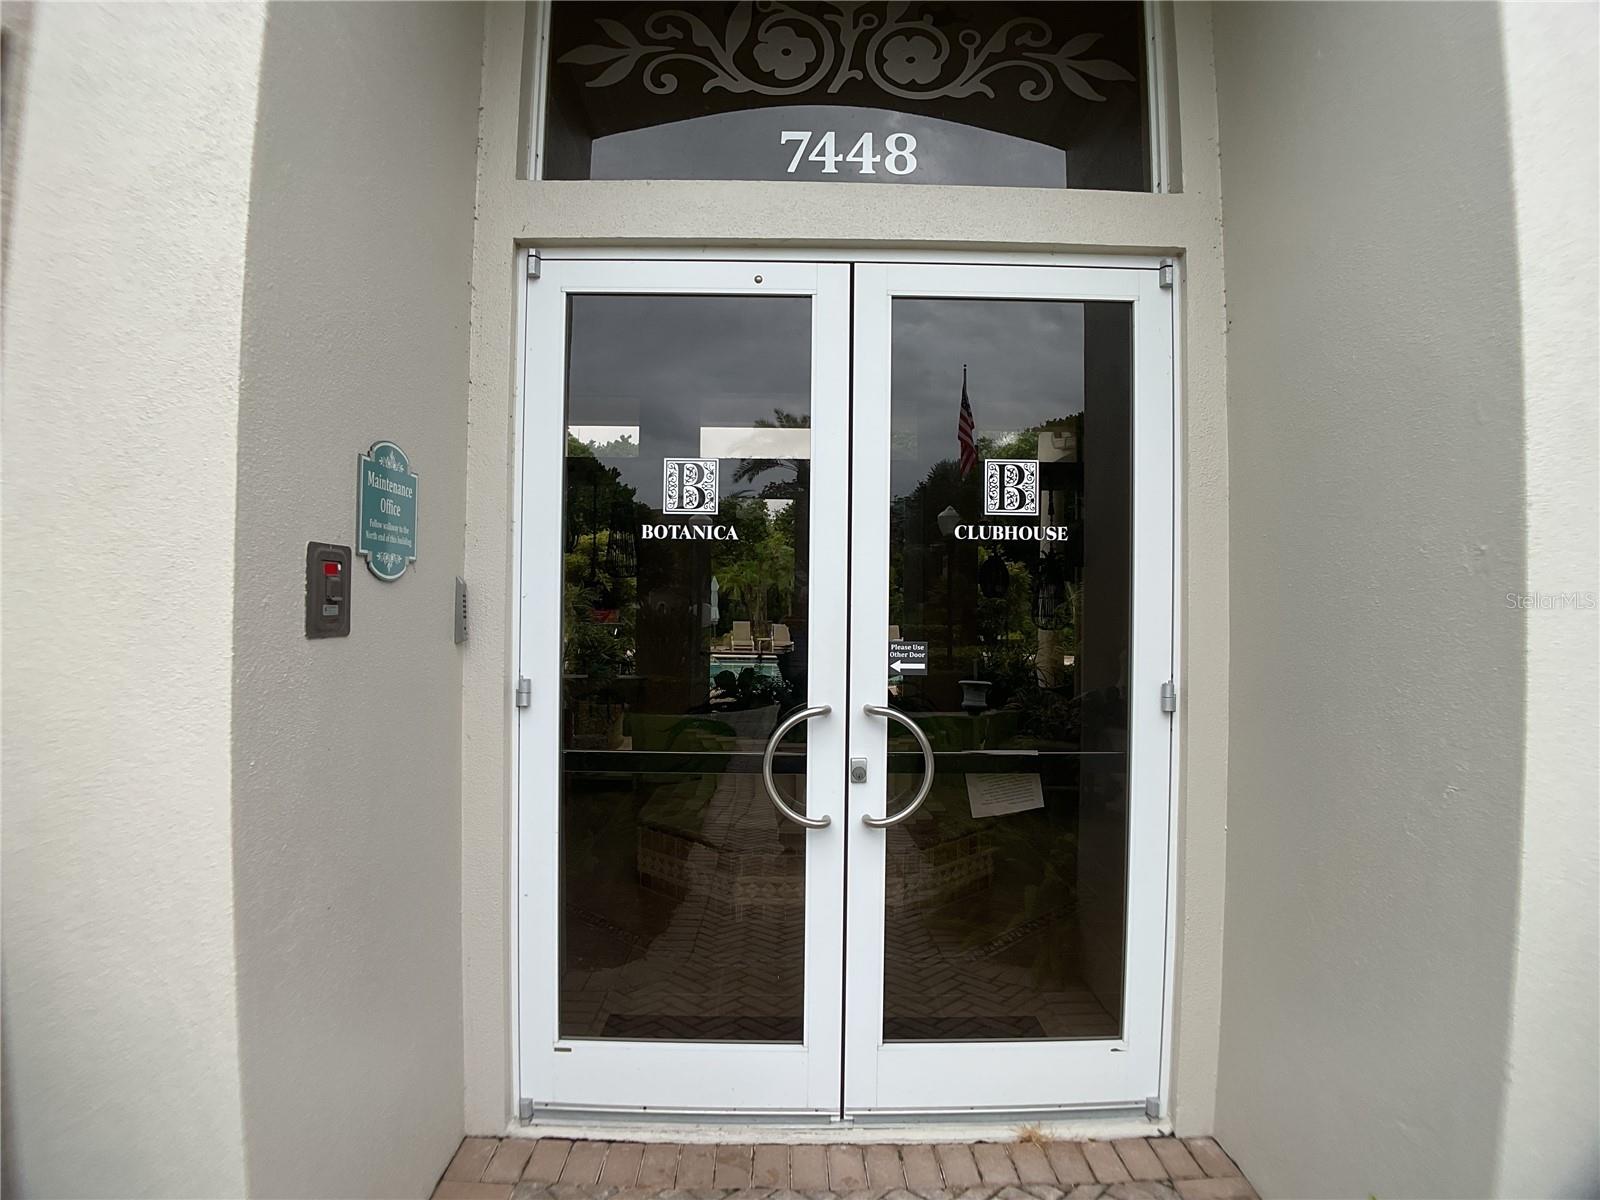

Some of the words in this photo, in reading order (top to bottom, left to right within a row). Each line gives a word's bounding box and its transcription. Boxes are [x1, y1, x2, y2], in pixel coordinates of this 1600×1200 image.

[780, 130, 918, 175] 7448
[367, 471, 413, 498] Maintenance
[380, 498, 401, 517] Office
[641, 524, 739, 540] BOTANICA
[954, 524, 1069, 541] CLUBHOUSE
